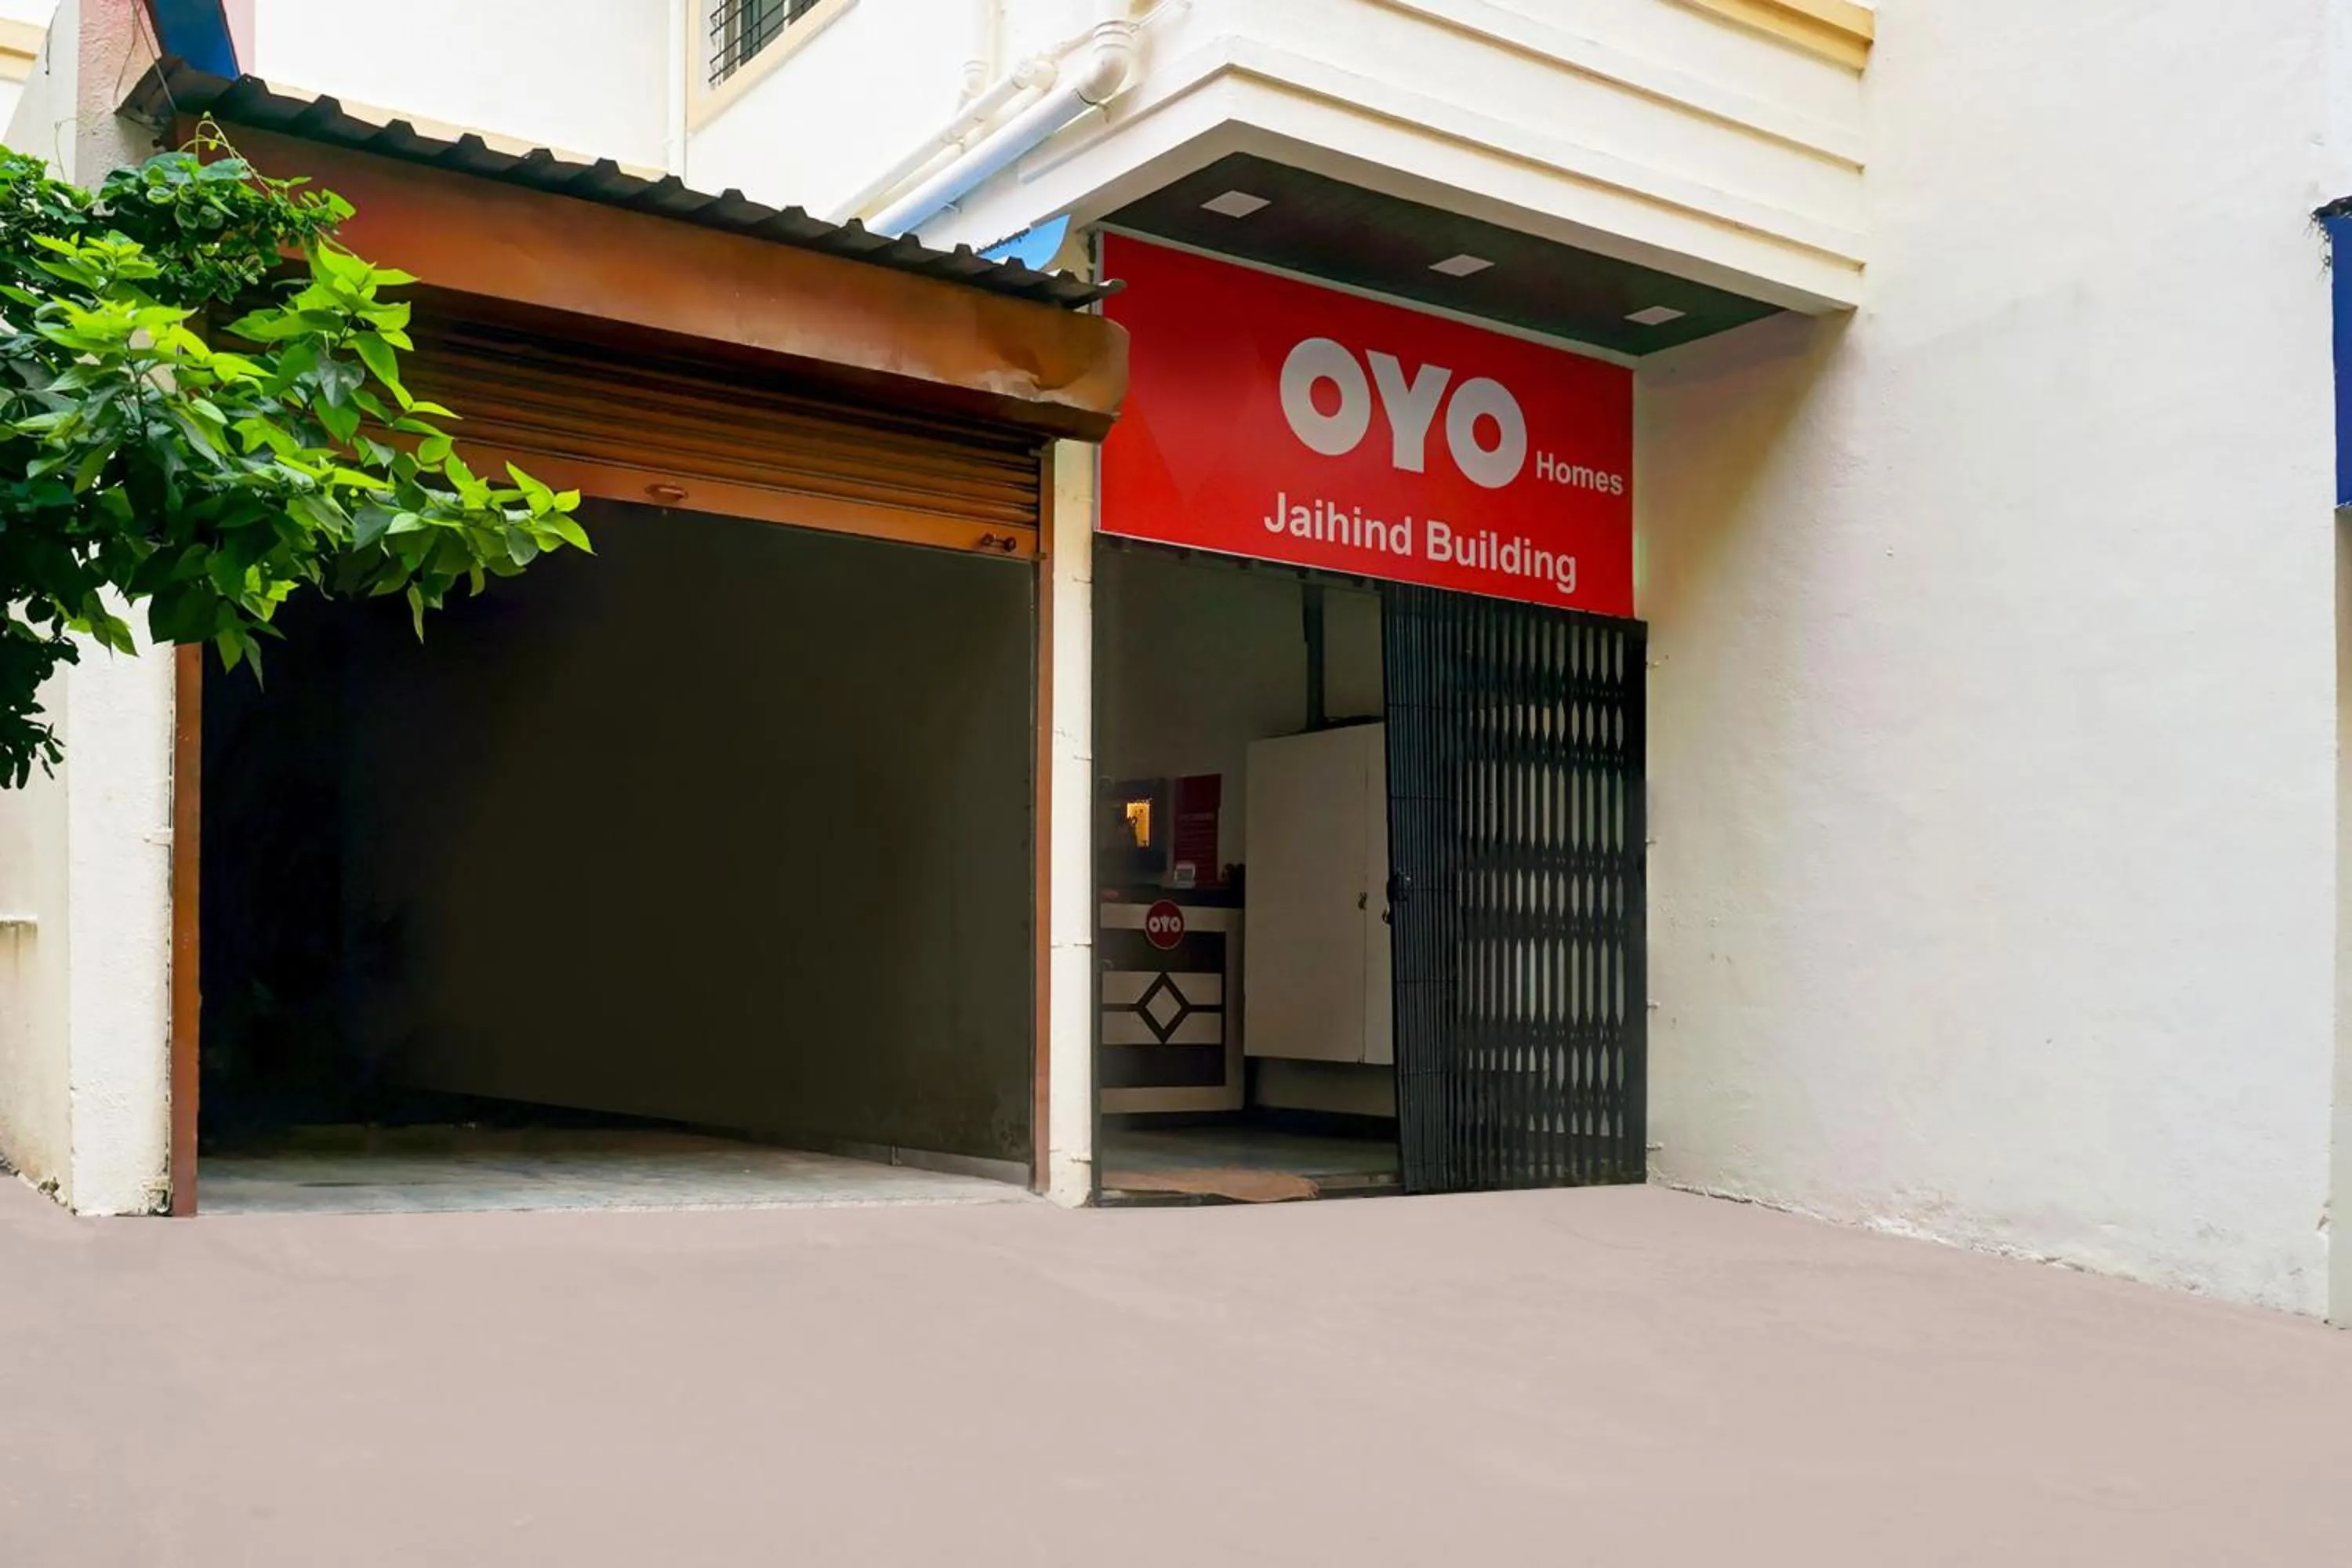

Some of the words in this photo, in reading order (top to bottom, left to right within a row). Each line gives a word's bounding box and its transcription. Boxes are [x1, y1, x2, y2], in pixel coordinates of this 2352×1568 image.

[1279, 337, 1528, 489] OYO
[1536, 451, 1624, 495] Homes
[1263, 492, 1412, 556] Jaihind
[1426, 520, 1577, 593] Building
[1148, 915, 1181, 933] OYO
